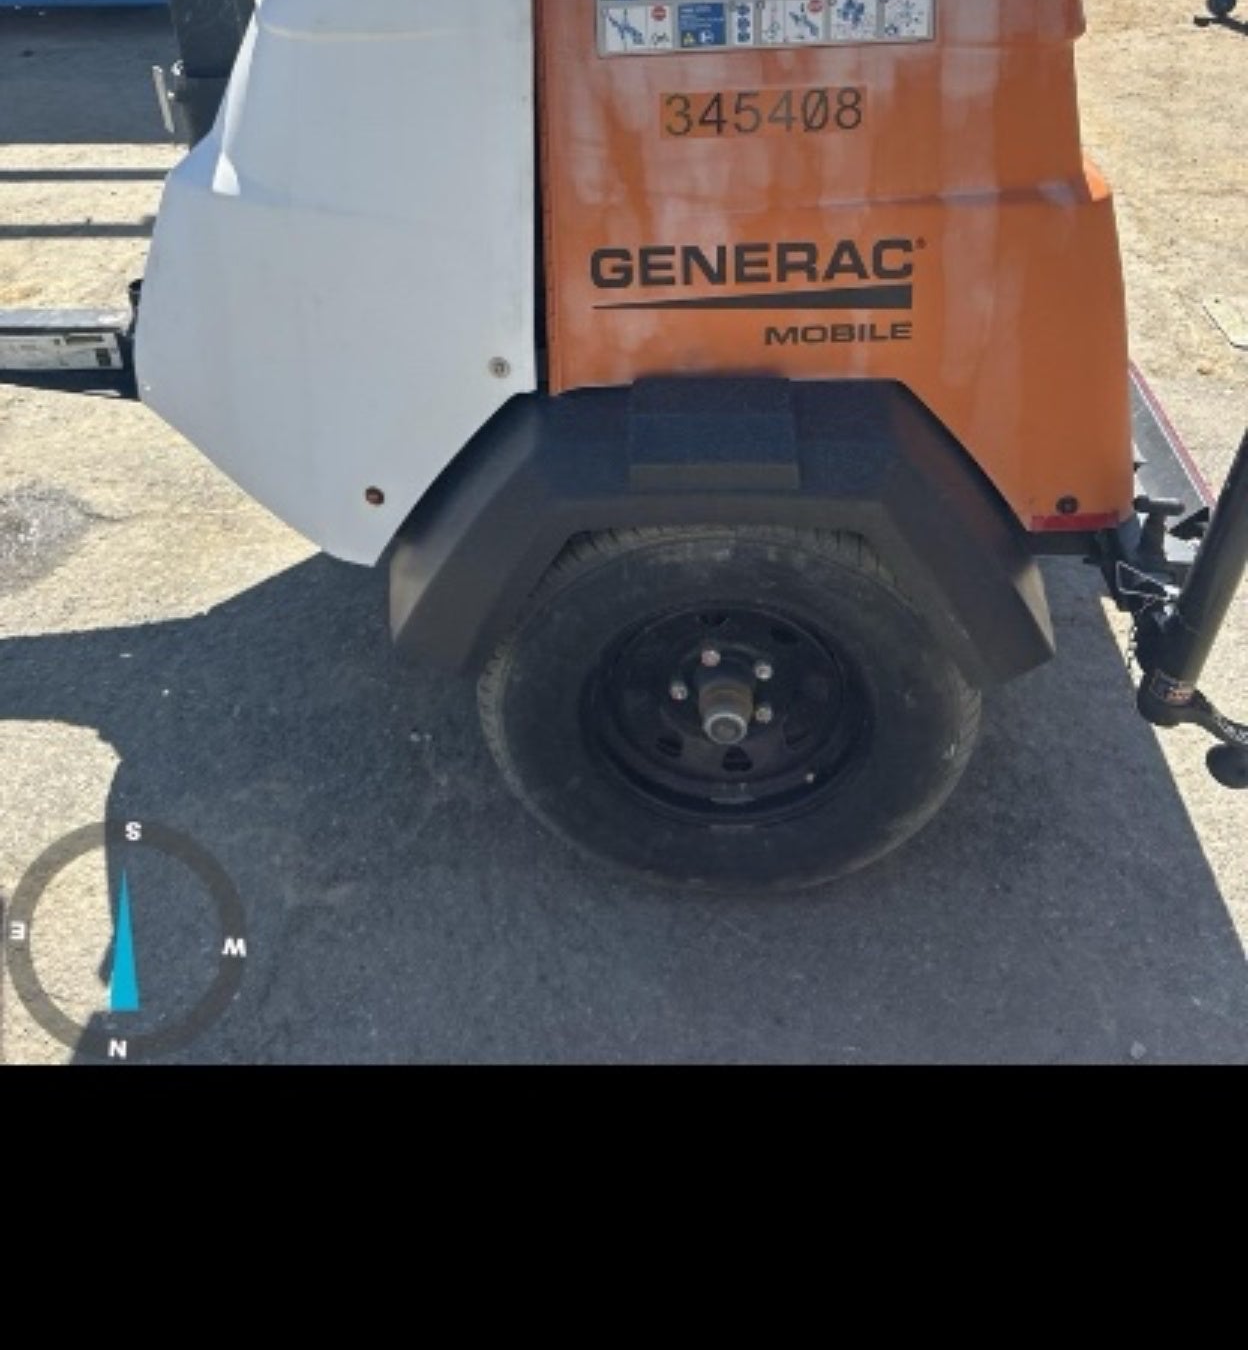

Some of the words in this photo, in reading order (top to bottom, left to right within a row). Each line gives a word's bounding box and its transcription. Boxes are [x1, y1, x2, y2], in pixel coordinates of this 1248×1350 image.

[664, 86, 863, 137] 345408
[590, 238, 914, 290] GENERAC
[764, 322, 914, 346] MOBILE
